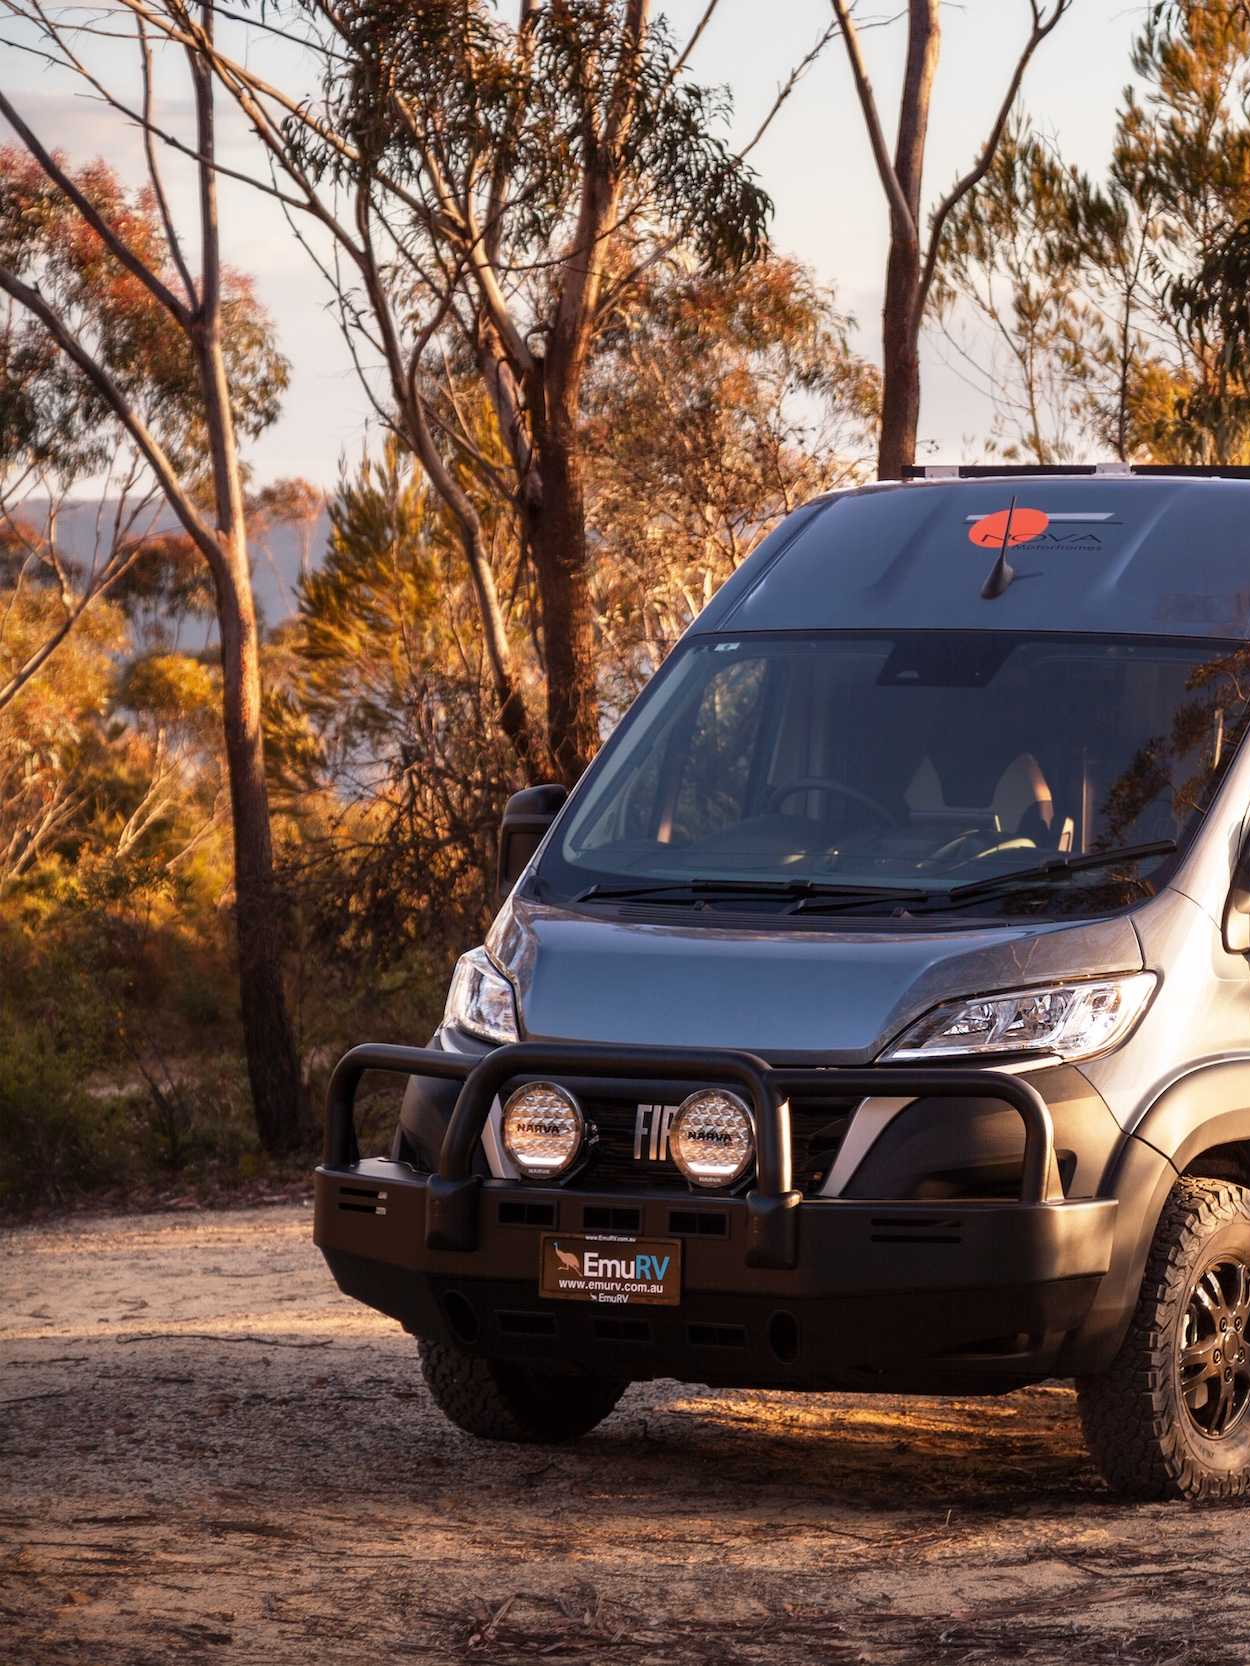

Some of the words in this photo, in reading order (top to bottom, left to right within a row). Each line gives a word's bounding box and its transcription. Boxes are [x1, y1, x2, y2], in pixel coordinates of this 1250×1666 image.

[517, 1123, 560, 1134] NARVA
[634, 1104, 681, 1161] FIA
[688, 1131, 732, 1142] NARVA
[583, 1252, 670, 1280] EmuRV
[559, 1279, 663, 1293] www.emurv.com.au
[599, 1293, 629, 1303] EmuRV
